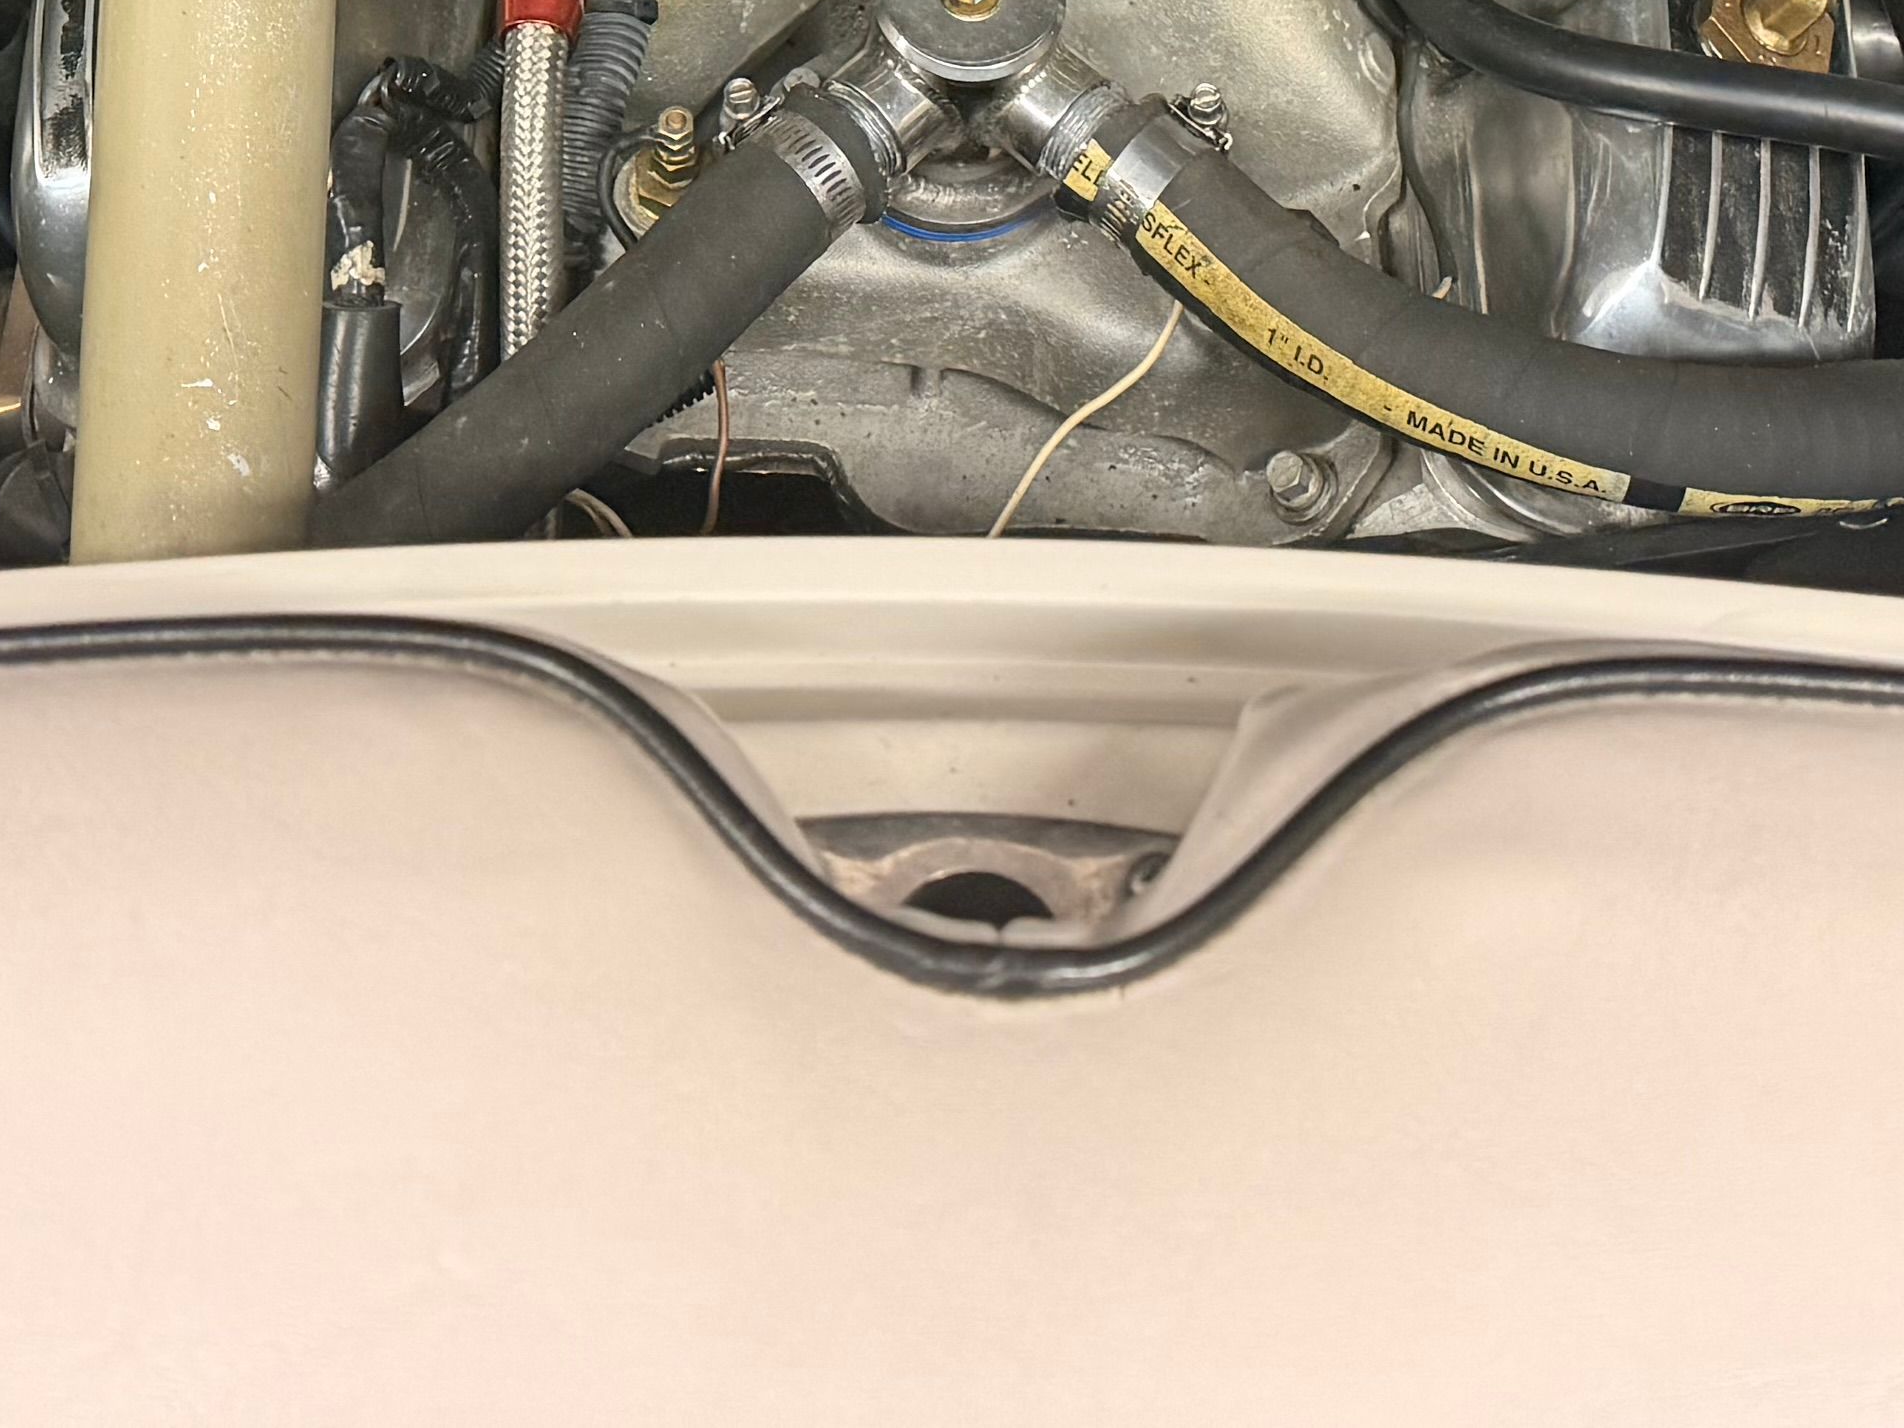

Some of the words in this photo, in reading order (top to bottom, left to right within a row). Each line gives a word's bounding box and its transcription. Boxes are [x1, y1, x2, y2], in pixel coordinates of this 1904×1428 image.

[1293, 345, 1330, 383] I.D.
[1405, 410, 1486, 456] MADE
[1493, 446, 1521, 470] IN
[1529, 460, 1608, 495] U.S.A.
